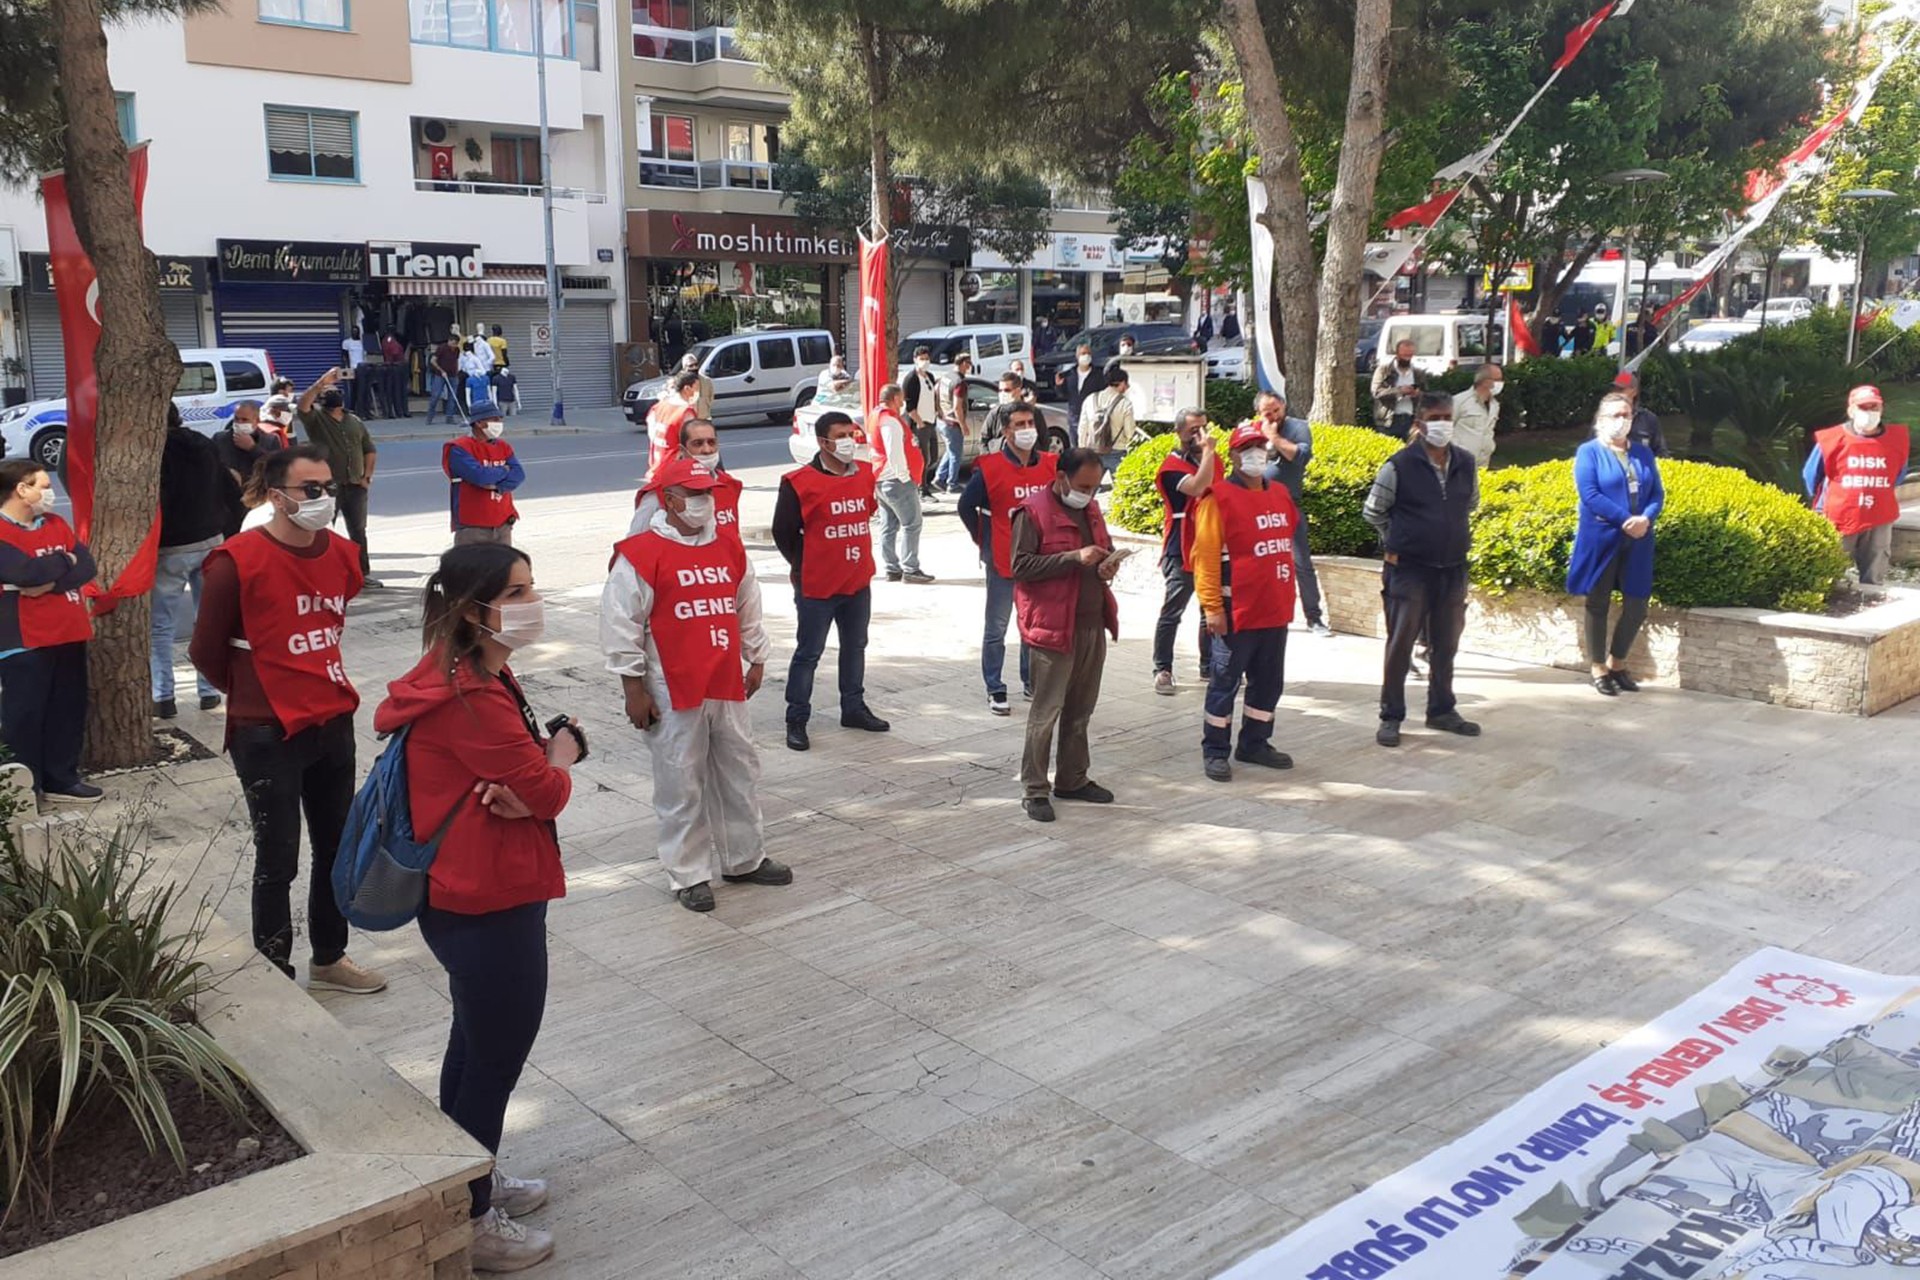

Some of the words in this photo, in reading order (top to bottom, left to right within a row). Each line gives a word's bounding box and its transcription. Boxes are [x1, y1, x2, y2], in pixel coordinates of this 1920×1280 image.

[369, 247, 483, 278] Trend
[1847, 454, 1887, 469] DİSK
[716, 508, 736, 525] SK
[830, 496, 866, 515] DİSK
[1256, 510, 1289, 530] DİSK
[845, 544, 861, 564] İŞ
[1254, 538, 1292, 557] GENE
[677, 564, 732, 587] DİSK
[1276, 561, 1290, 583] İŞ
[709, 624, 730, 651] İŞ
[1712, 995, 1787, 1033] DİSK
[1588, 1038, 1725, 1110] GENEL-İŞ
[1516, 1102, 1635, 1162] İZMİR
[1494, 1151, 1546, 1173] 2
